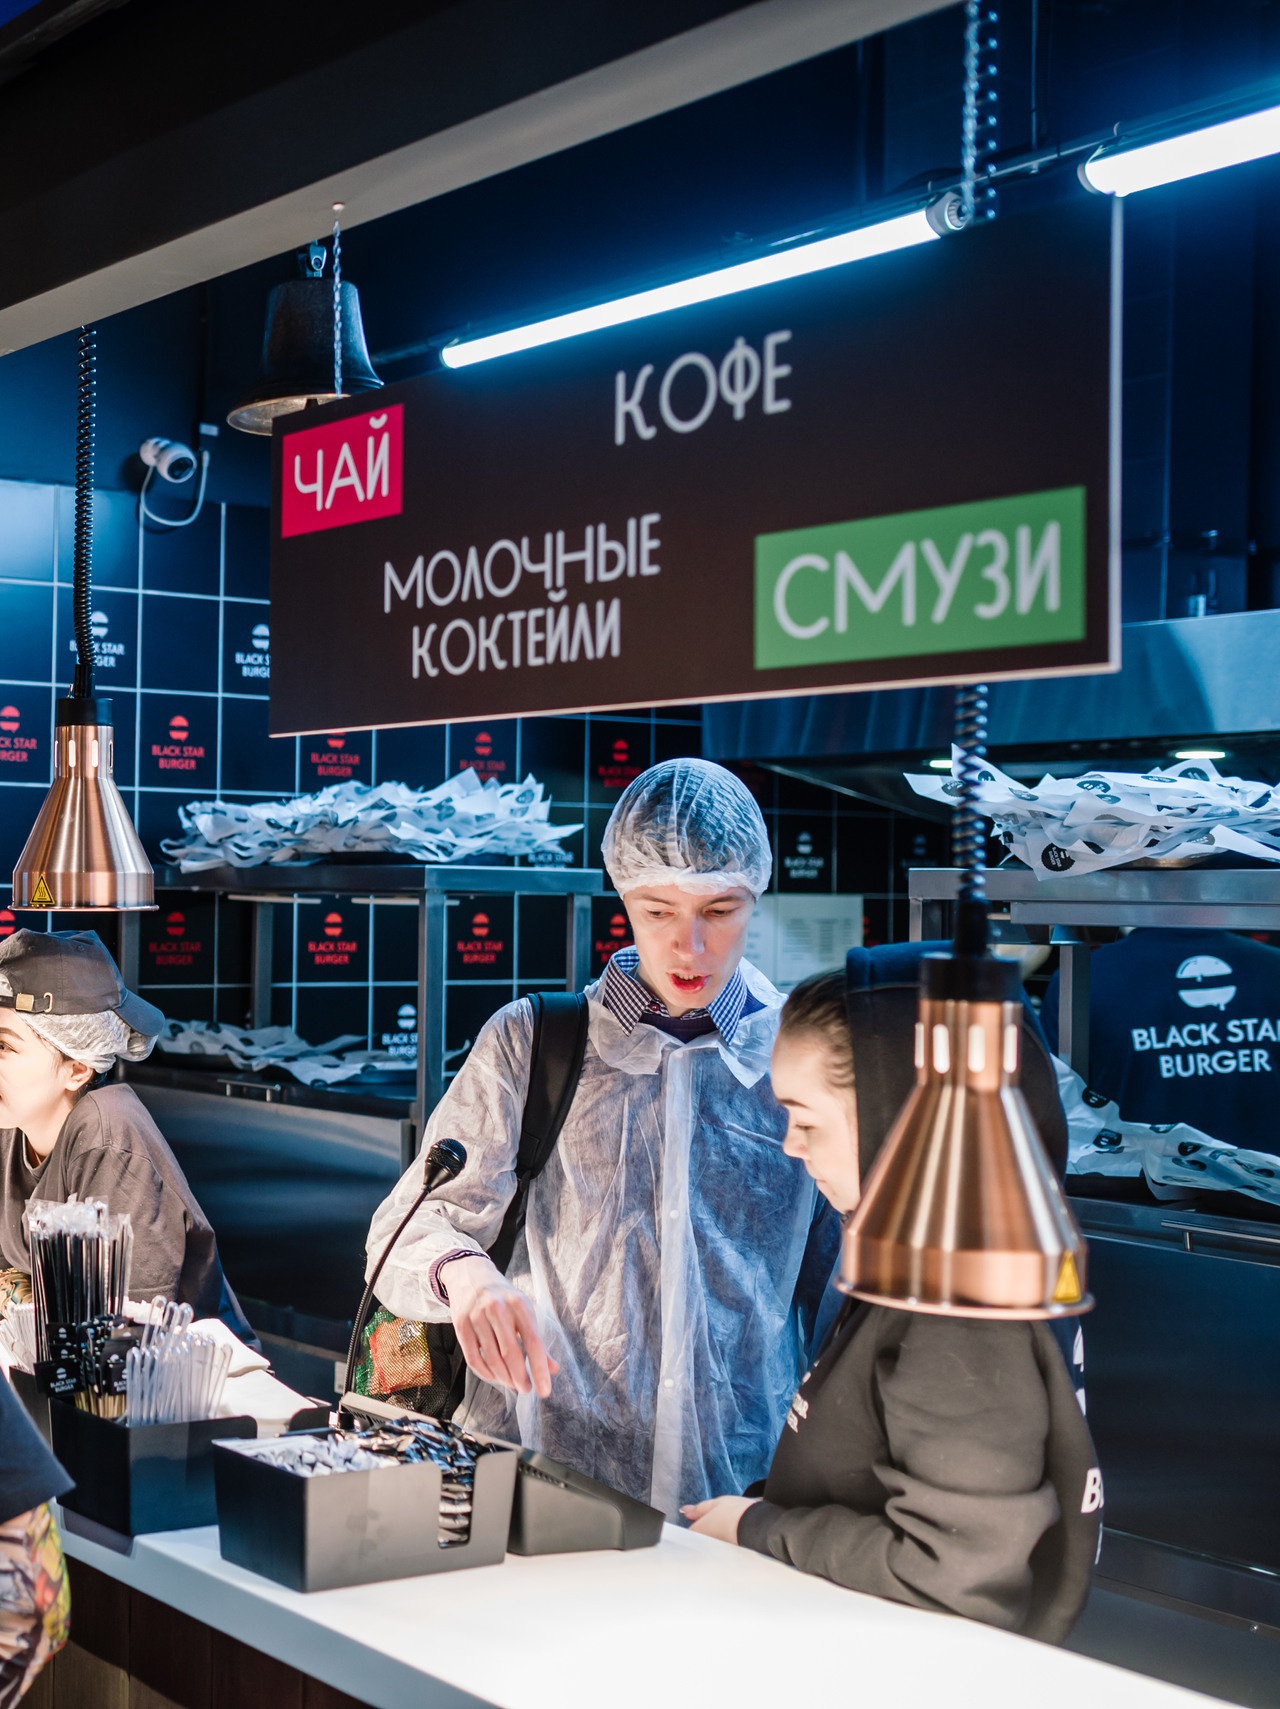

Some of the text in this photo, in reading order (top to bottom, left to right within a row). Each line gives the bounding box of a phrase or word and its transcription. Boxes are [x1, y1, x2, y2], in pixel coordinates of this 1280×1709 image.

[613, 330, 793, 447] КОФЕ
[293, 412, 391, 513] ЧАЙ
[382, 513, 662, 614] МОЛОЧНЫЕ
[773, 520, 1062, 640] СМУЗИ
[412, 588, 621, 680] КОКТЕЙЛИ
[102, 643, 125, 655] STAR
[235, 652, 265, 664] BLACK
[242, 666, 270, 678] BURG
[13, 737, 37, 749] STAR
[151, 745, 205, 758] BLACK STAR
[158, 758, 196, 770] BURGER
[339, 754, 360, 765] STAR
[1131, 1022, 1221, 1051] BLACK
[1159, 1048, 1272, 1079] BURGER
